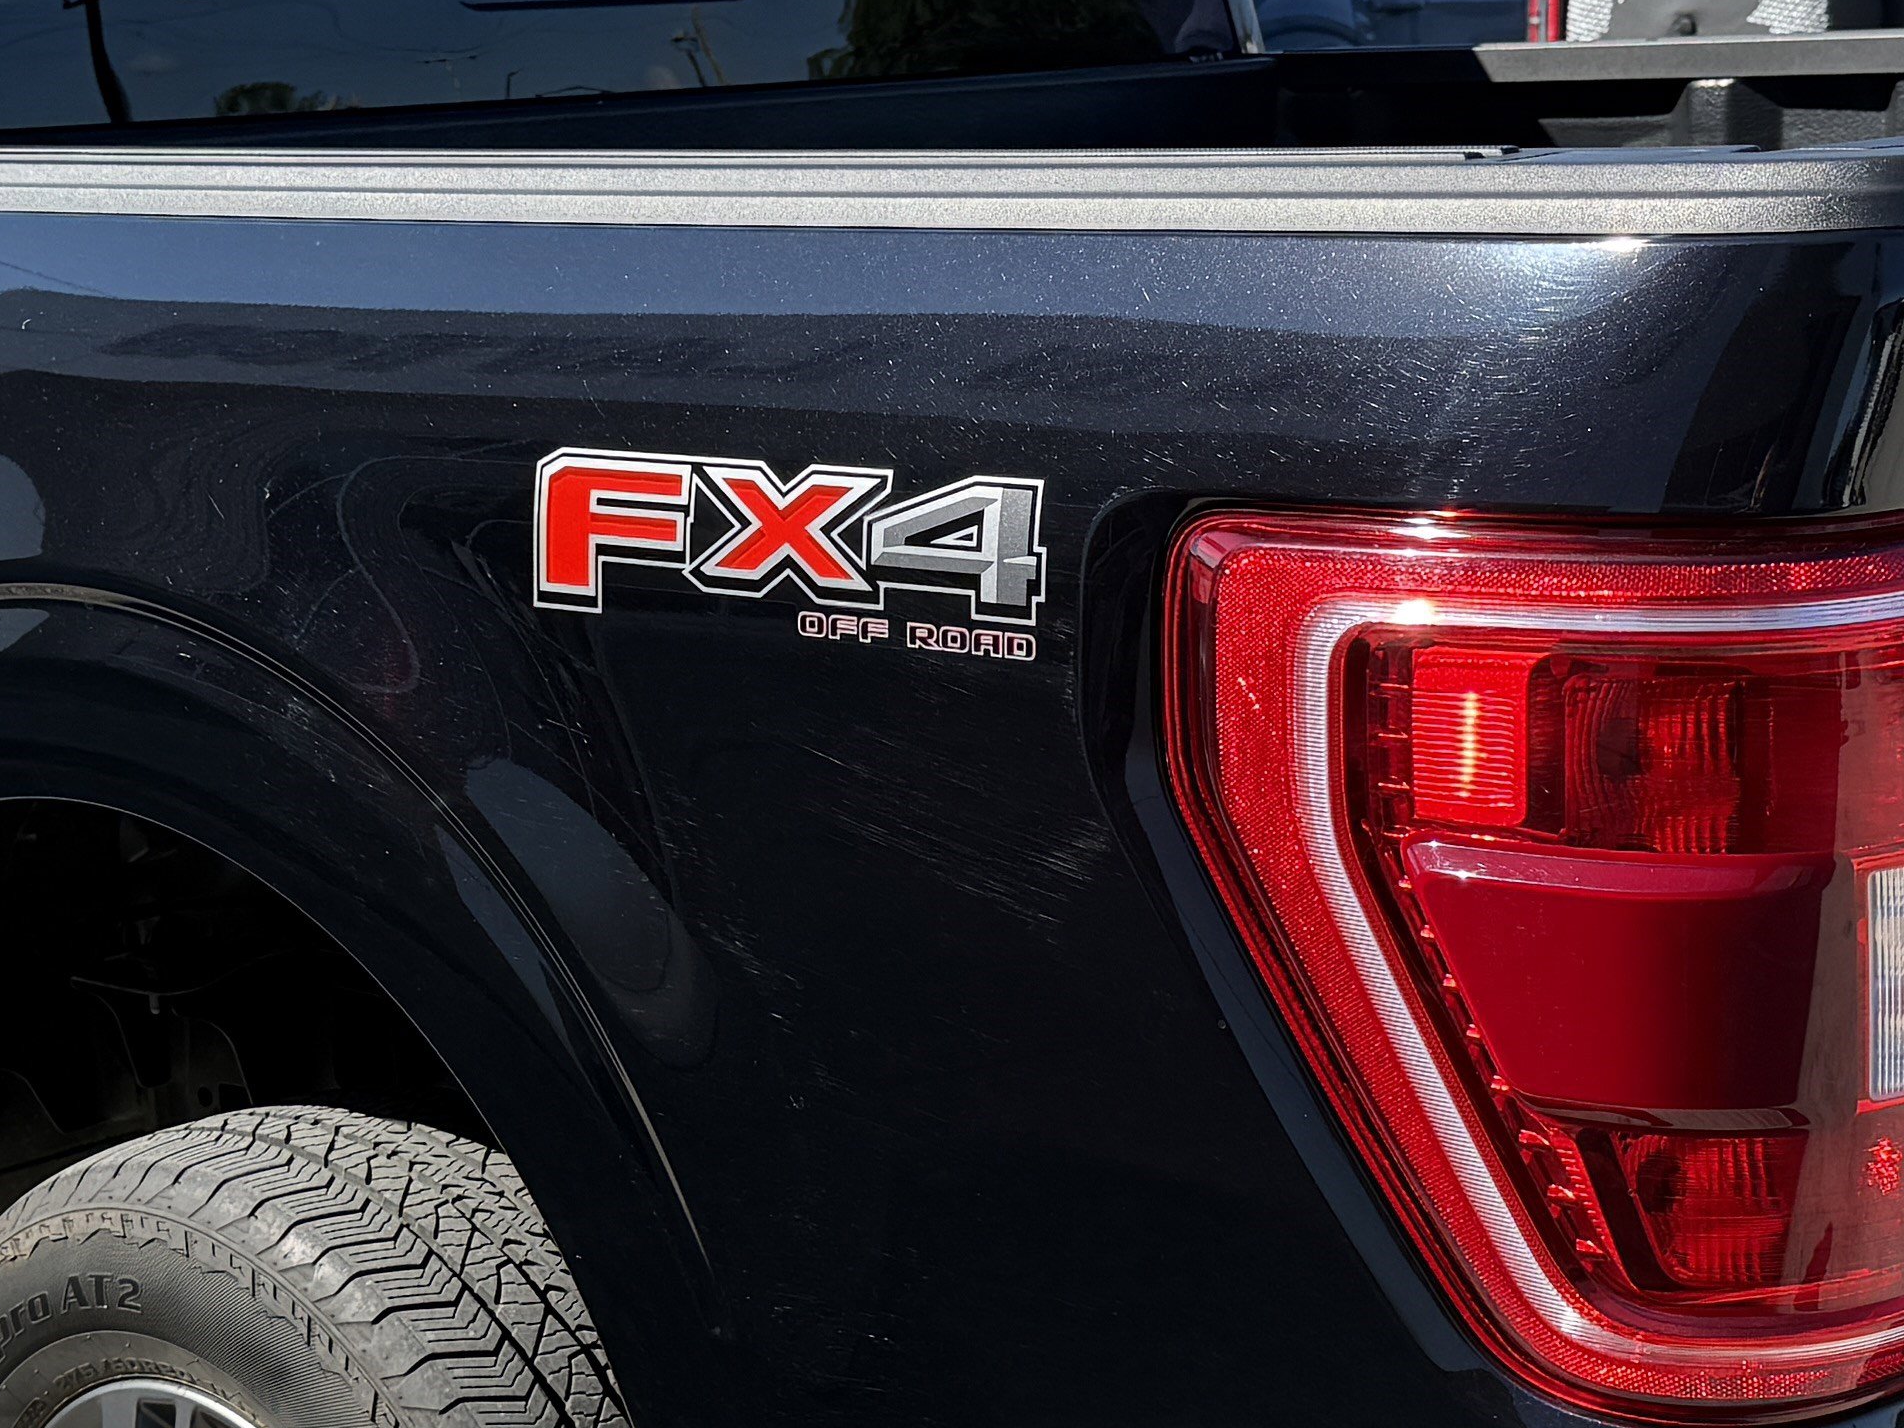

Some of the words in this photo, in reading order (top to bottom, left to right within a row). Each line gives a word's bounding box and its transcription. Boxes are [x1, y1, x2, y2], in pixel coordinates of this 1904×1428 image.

[532, 446, 1047, 626] FX4
[797, 609, 890, 644] OFF
[905, 621, 1038, 662] ROAD
